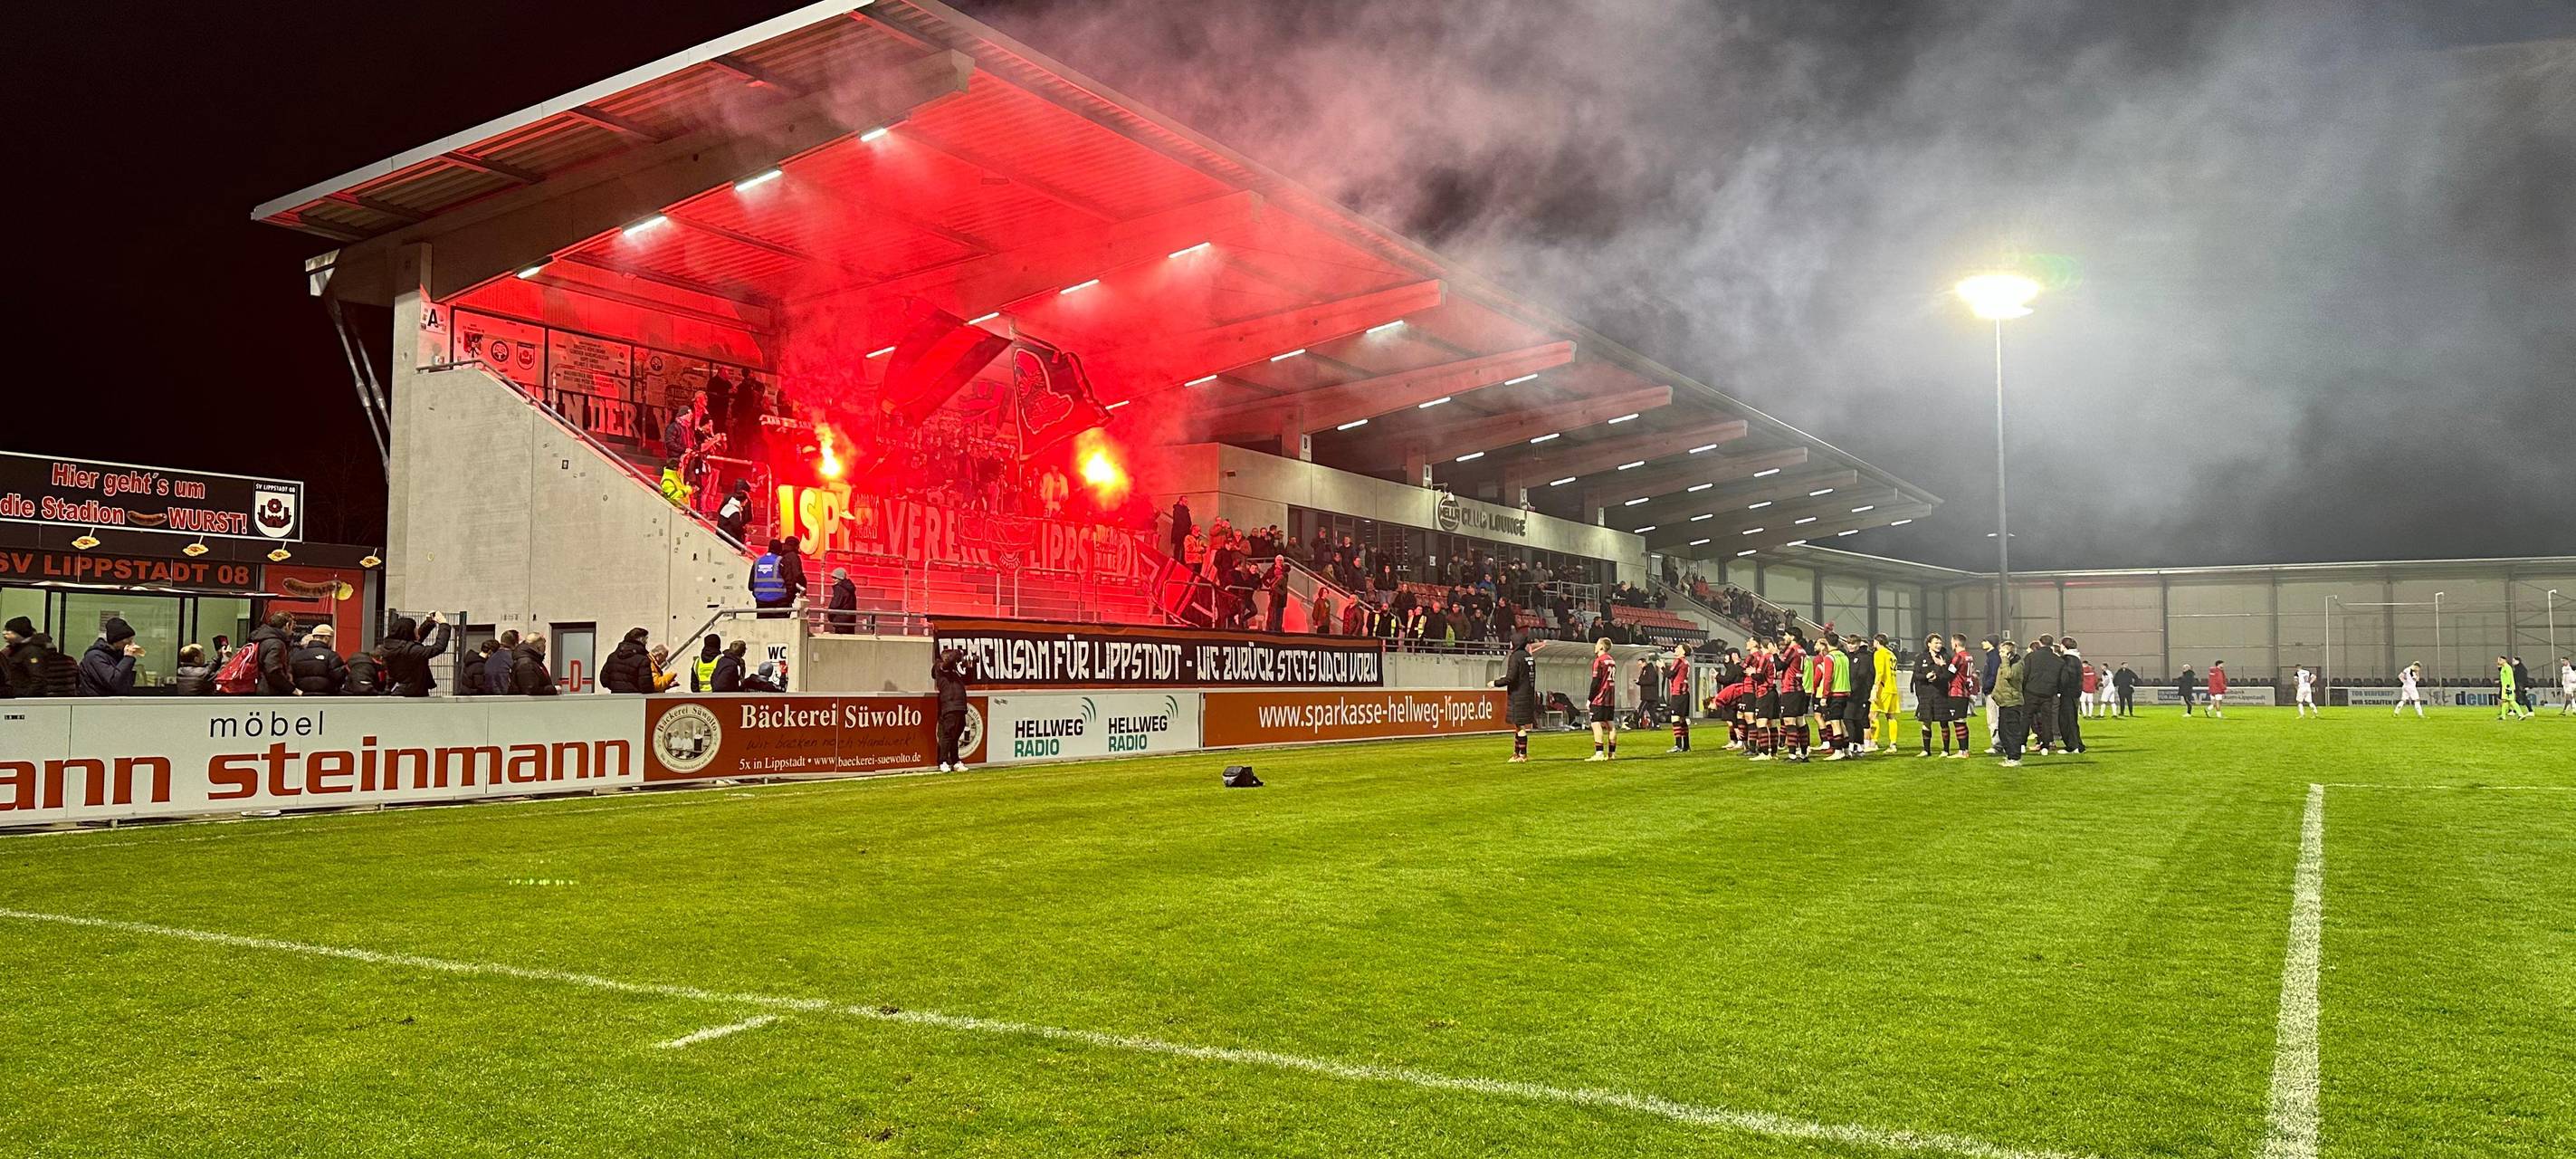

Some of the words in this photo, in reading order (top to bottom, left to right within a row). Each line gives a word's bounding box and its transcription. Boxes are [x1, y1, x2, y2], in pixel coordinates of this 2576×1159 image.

[428, 309, 438, 327] A
[52, 463, 100, 489] Hier
[175, 481, 205, 499] um
[0, 493, 35, 517] die
[42, 496, 125, 524] Stadion
[167, 507, 247, 534] WURST!
[1462, 507, 1487, 529] CLUB
[1489, 513, 1526, 537] LOUNGE
[45, 555, 209, 583] LIPPSTADT
[218, 565, 249, 584] 08
[768, 646, 787, 660] WC
[1054, 634, 1089, 680] FÜR
[1094, 641, 1181, 680] LIPPSTADT
[1196, 645, 1220, 681] NIE
[1224, 642, 1274, 681] ZURÜCK
[1277, 649, 1316, 682] STETS
[1318, 651, 1348, 683] NACH
[1350, 652, 1379, 683] VORN
[569, 659, 582, 693] D
[210, 711, 324, 738] möbel
[739, 703, 837, 729] Bäckerei
[844, 704, 922, 728] Süwolto
[1108, 714, 1169, 734] HELLWEG
[1257, 694, 1493, 733] www.sparkasse-hellweg-lippe.de
[1015, 718, 1084, 739] HELLWEG
[1014, 738, 1060, 758] RADIO
[1108, 734, 1148, 752] RADIO
[207, 735, 631, 800] steinmann
[739, 758, 750, 770] 5x
[754, 758, 762, 770] in
[765, 755, 806, 771] Lippstadt
[814, 752, 921, 768] wwwbaeckerei-suewolto.de
